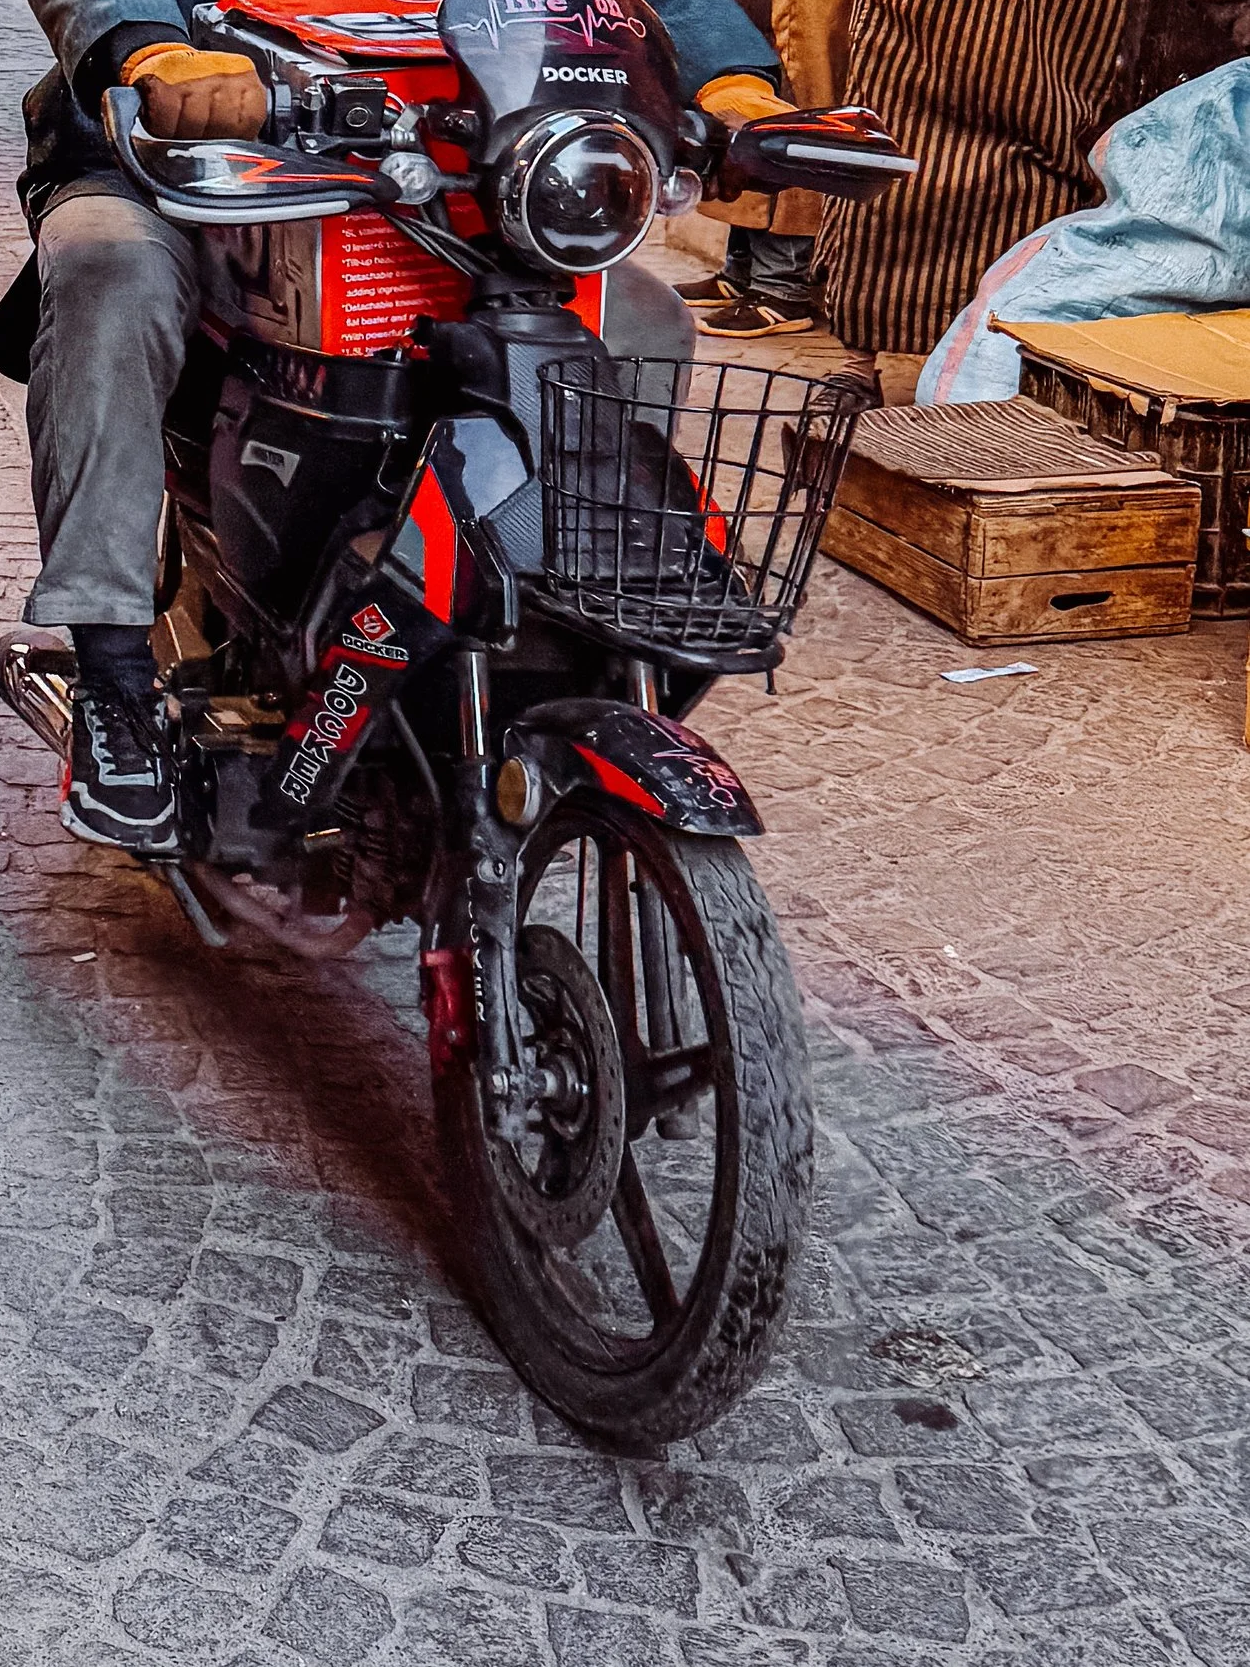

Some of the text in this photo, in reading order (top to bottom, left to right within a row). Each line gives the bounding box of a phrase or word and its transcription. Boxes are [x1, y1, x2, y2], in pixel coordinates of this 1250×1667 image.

[542, 65, 629, 86] DOCKER
[343, 634, 409, 661] DOCKER
[280, 664, 368, 806] DOCKER
